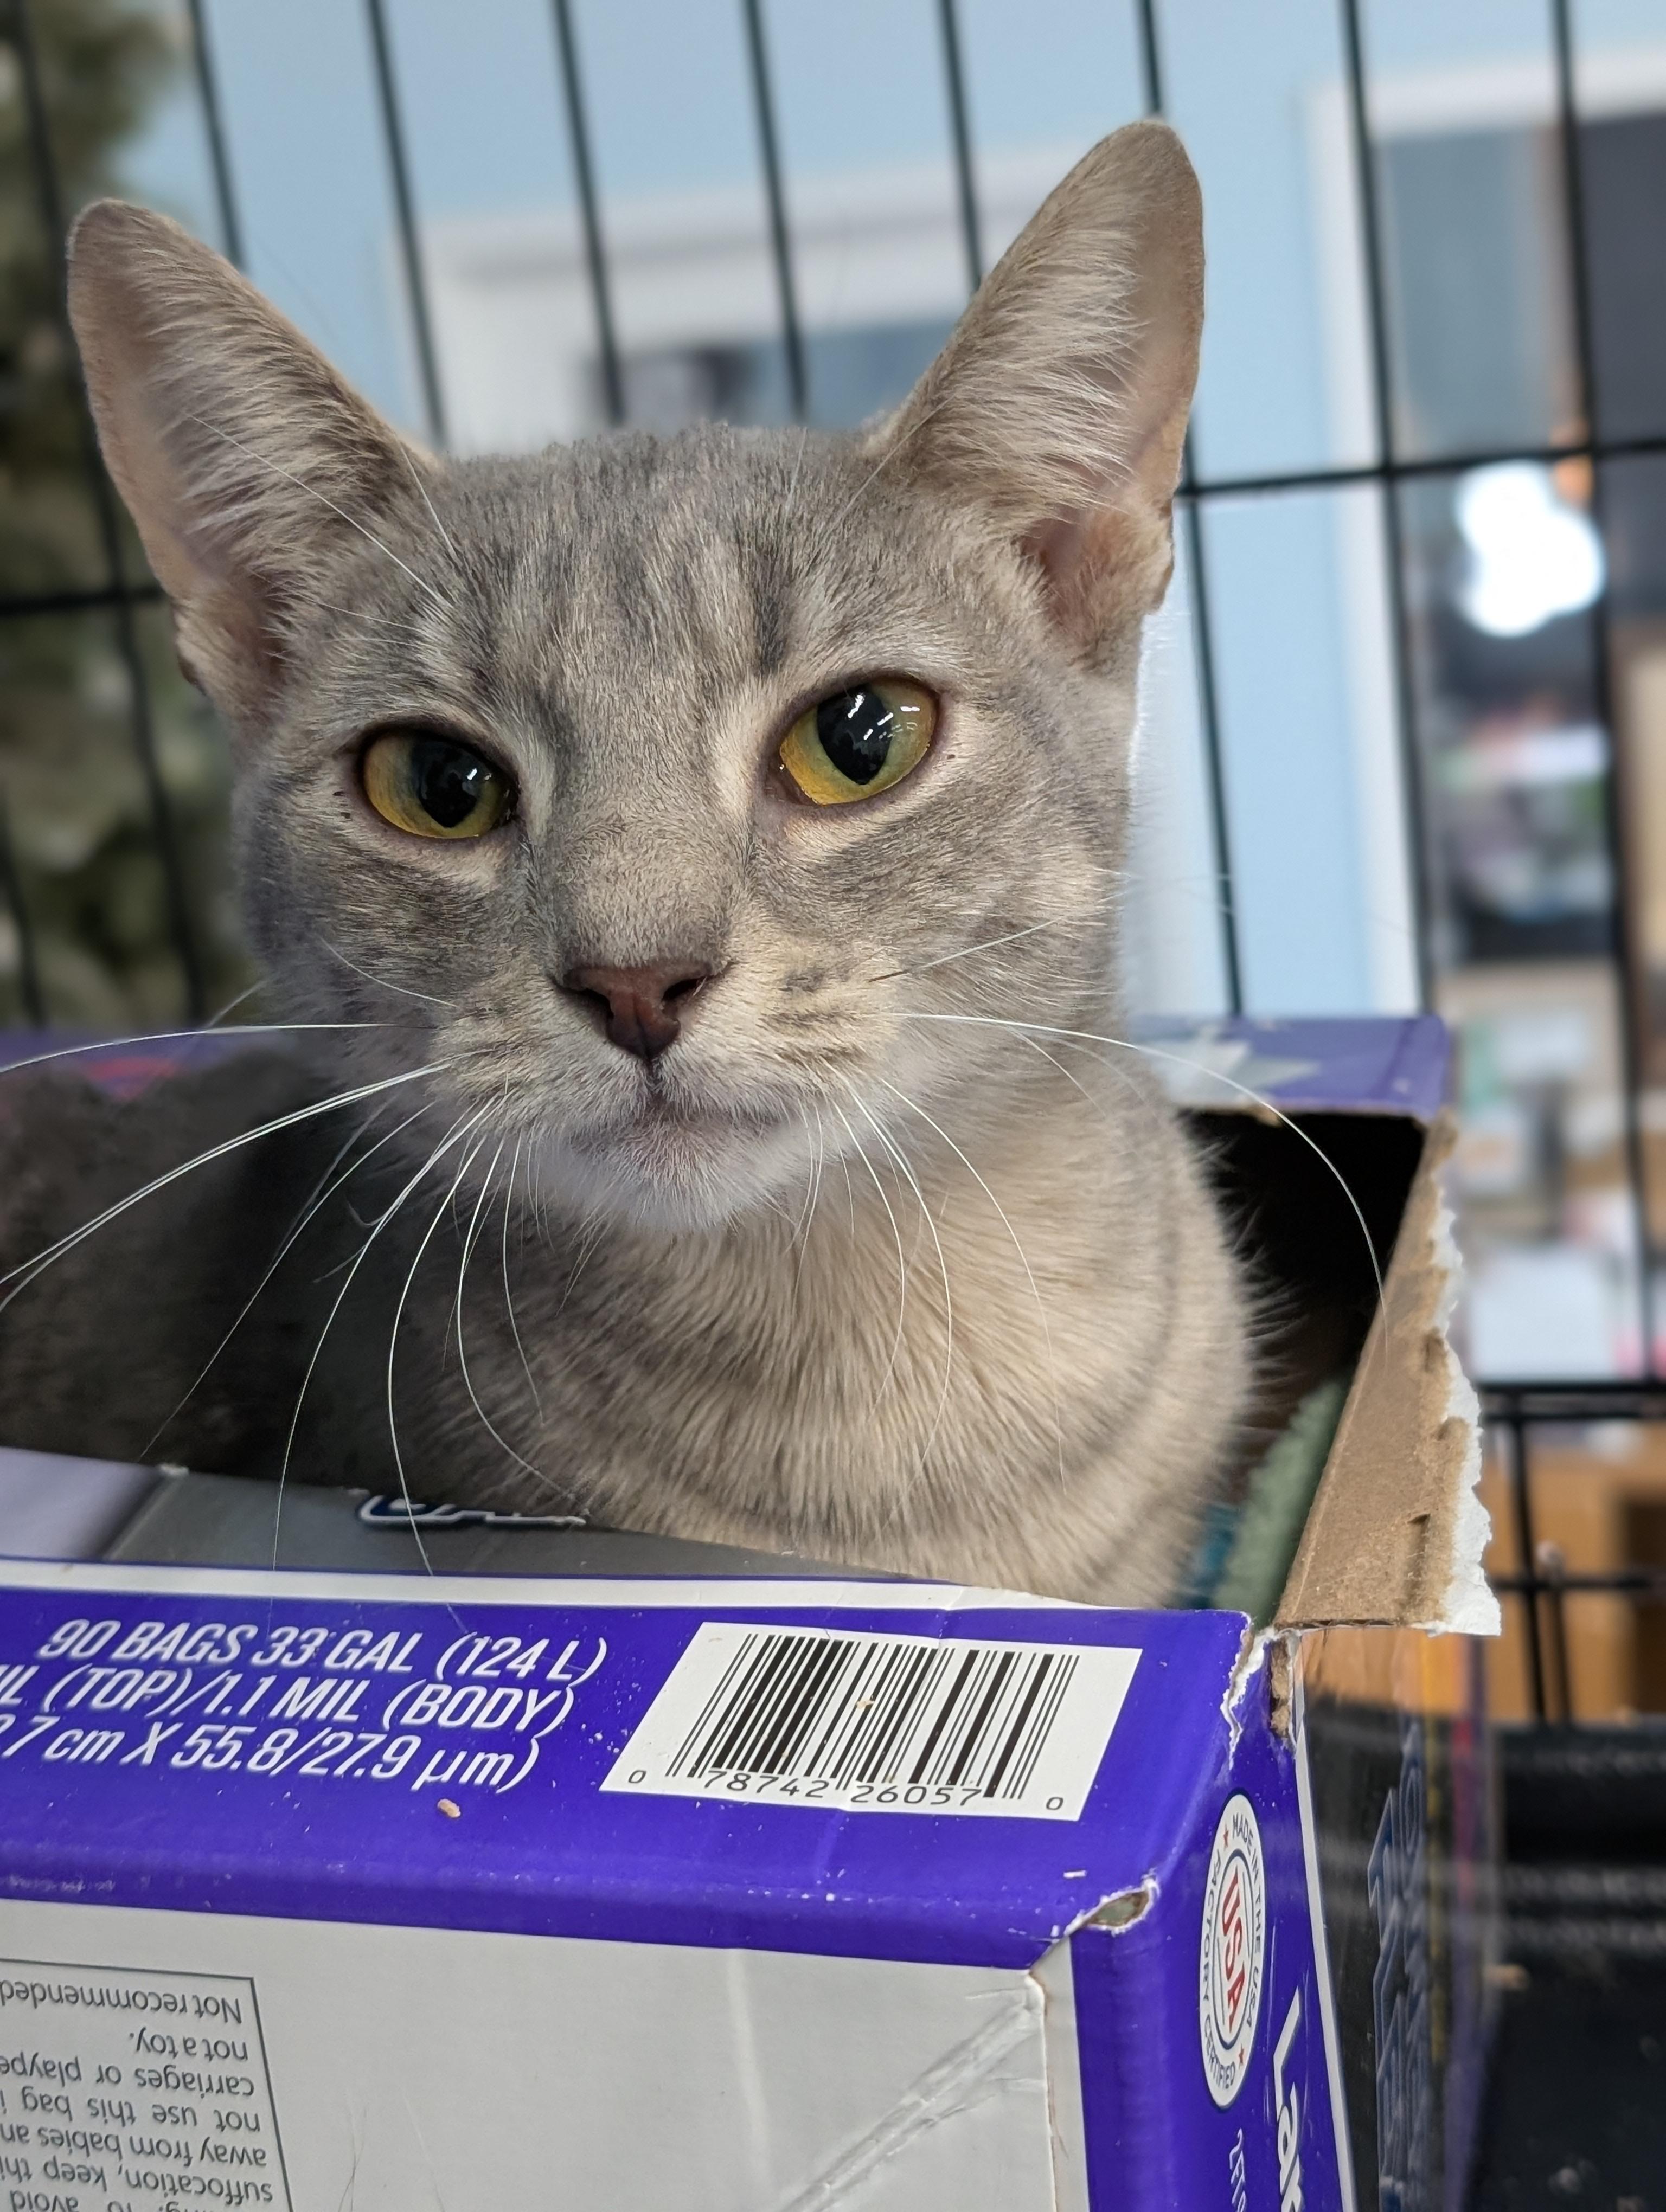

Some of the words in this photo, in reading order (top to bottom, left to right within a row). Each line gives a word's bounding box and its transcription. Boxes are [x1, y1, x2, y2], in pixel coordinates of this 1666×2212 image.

[39, 1619, 121, 1657] 90
[112, 1622, 259, 1663] BAGS
[251, 1626, 329, 1667] 33
[325, 1629, 423, 1673] GAL
[436, 1631, 550, 1680] (124
[545, 1637, 607, 1688] L)
[43, 1663, 277, 1718] (TOP)/1.1
[268, 1676, 370, 1721] MIL
[383, 1679, 574, 1739] (BODY)
[43, 1728, 126, 1764] cm
[119, 1721, 184, 1765] X
[171, 1724, 421, 1779] 55.8/27.9
[627, 1769, 647, 1784] 0
[704, 1770, 830, 1798] 78742
[850, 1785, 982, 1806] 26057
[1045, 1796, 1064, 1811] 0
[1232, 1812, 1253, 1856] MADE
[1251, 1848, 1259, 1885] IN
[1203, 1849, 1221, 2001] FACTORY
[1222, 1864, 1246, 2034] USA
[0, 1979, 187, 2015] recommended
[194, 1995, 242, 2024] Not
[1246, 1966, 1259, 2028] USA
[130, 2027, 179, 2059] toy.
[183, 2036, 197, 2049] a
[203, 2037, 248, 2061] not
[1204, 2013, 1236, 2089] CERTIFIED
[95, 2063, 122, 2085] or
[134, 2064, 254, 2099] carriages
[22, 2086, 73, 2121] bag
[87, 2097, 137, 2129] this
[152, 2104, 197, 2127] use
[215, 2109, 261, 2133] not
[38, 2125, 123, 2160] babies
[131, 2137, 193, 2168] from
[200, 2136, 267, 2167] away
[43, 2156, 107, 2192] keep
[118, 2164, 273, 2206] suffocation,
